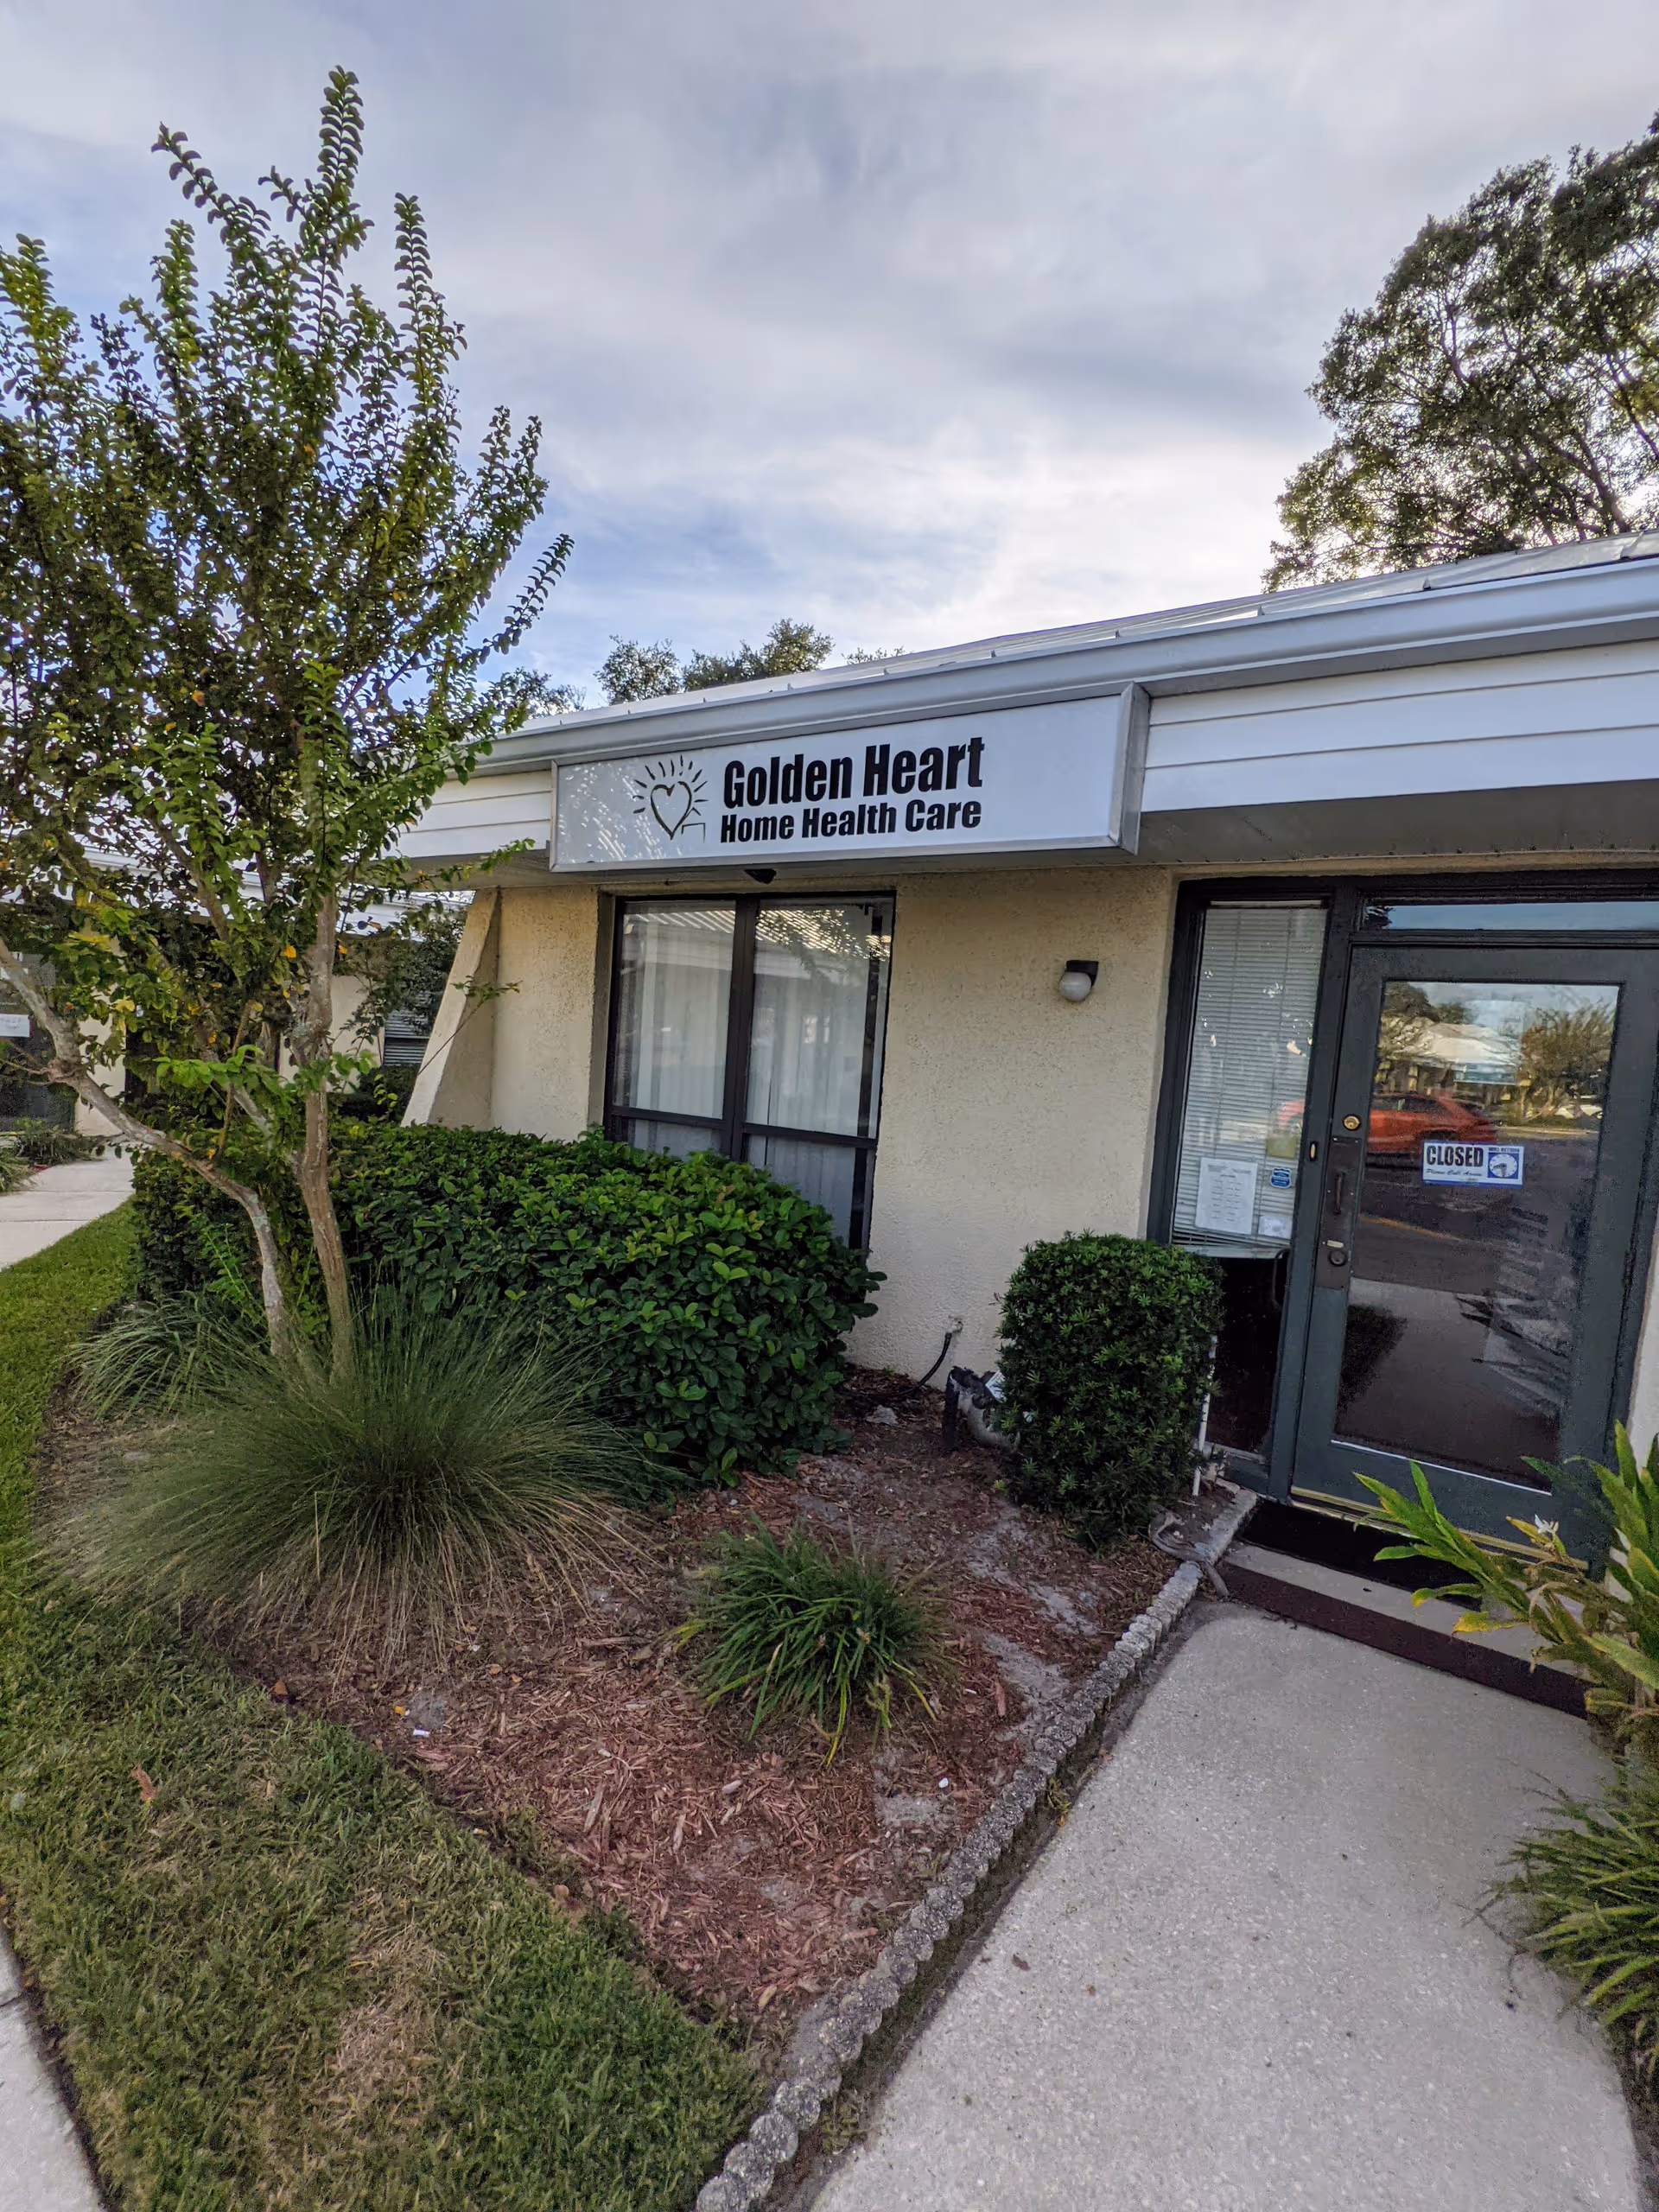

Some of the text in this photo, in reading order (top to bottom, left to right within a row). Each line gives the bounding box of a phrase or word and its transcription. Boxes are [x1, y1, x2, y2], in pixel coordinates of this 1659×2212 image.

[723, 736, 985, 809] Golden Heart
[720, 799, 982, 842] Home Health Care
[1427, 1145, 1484, 1167] CLOSED
